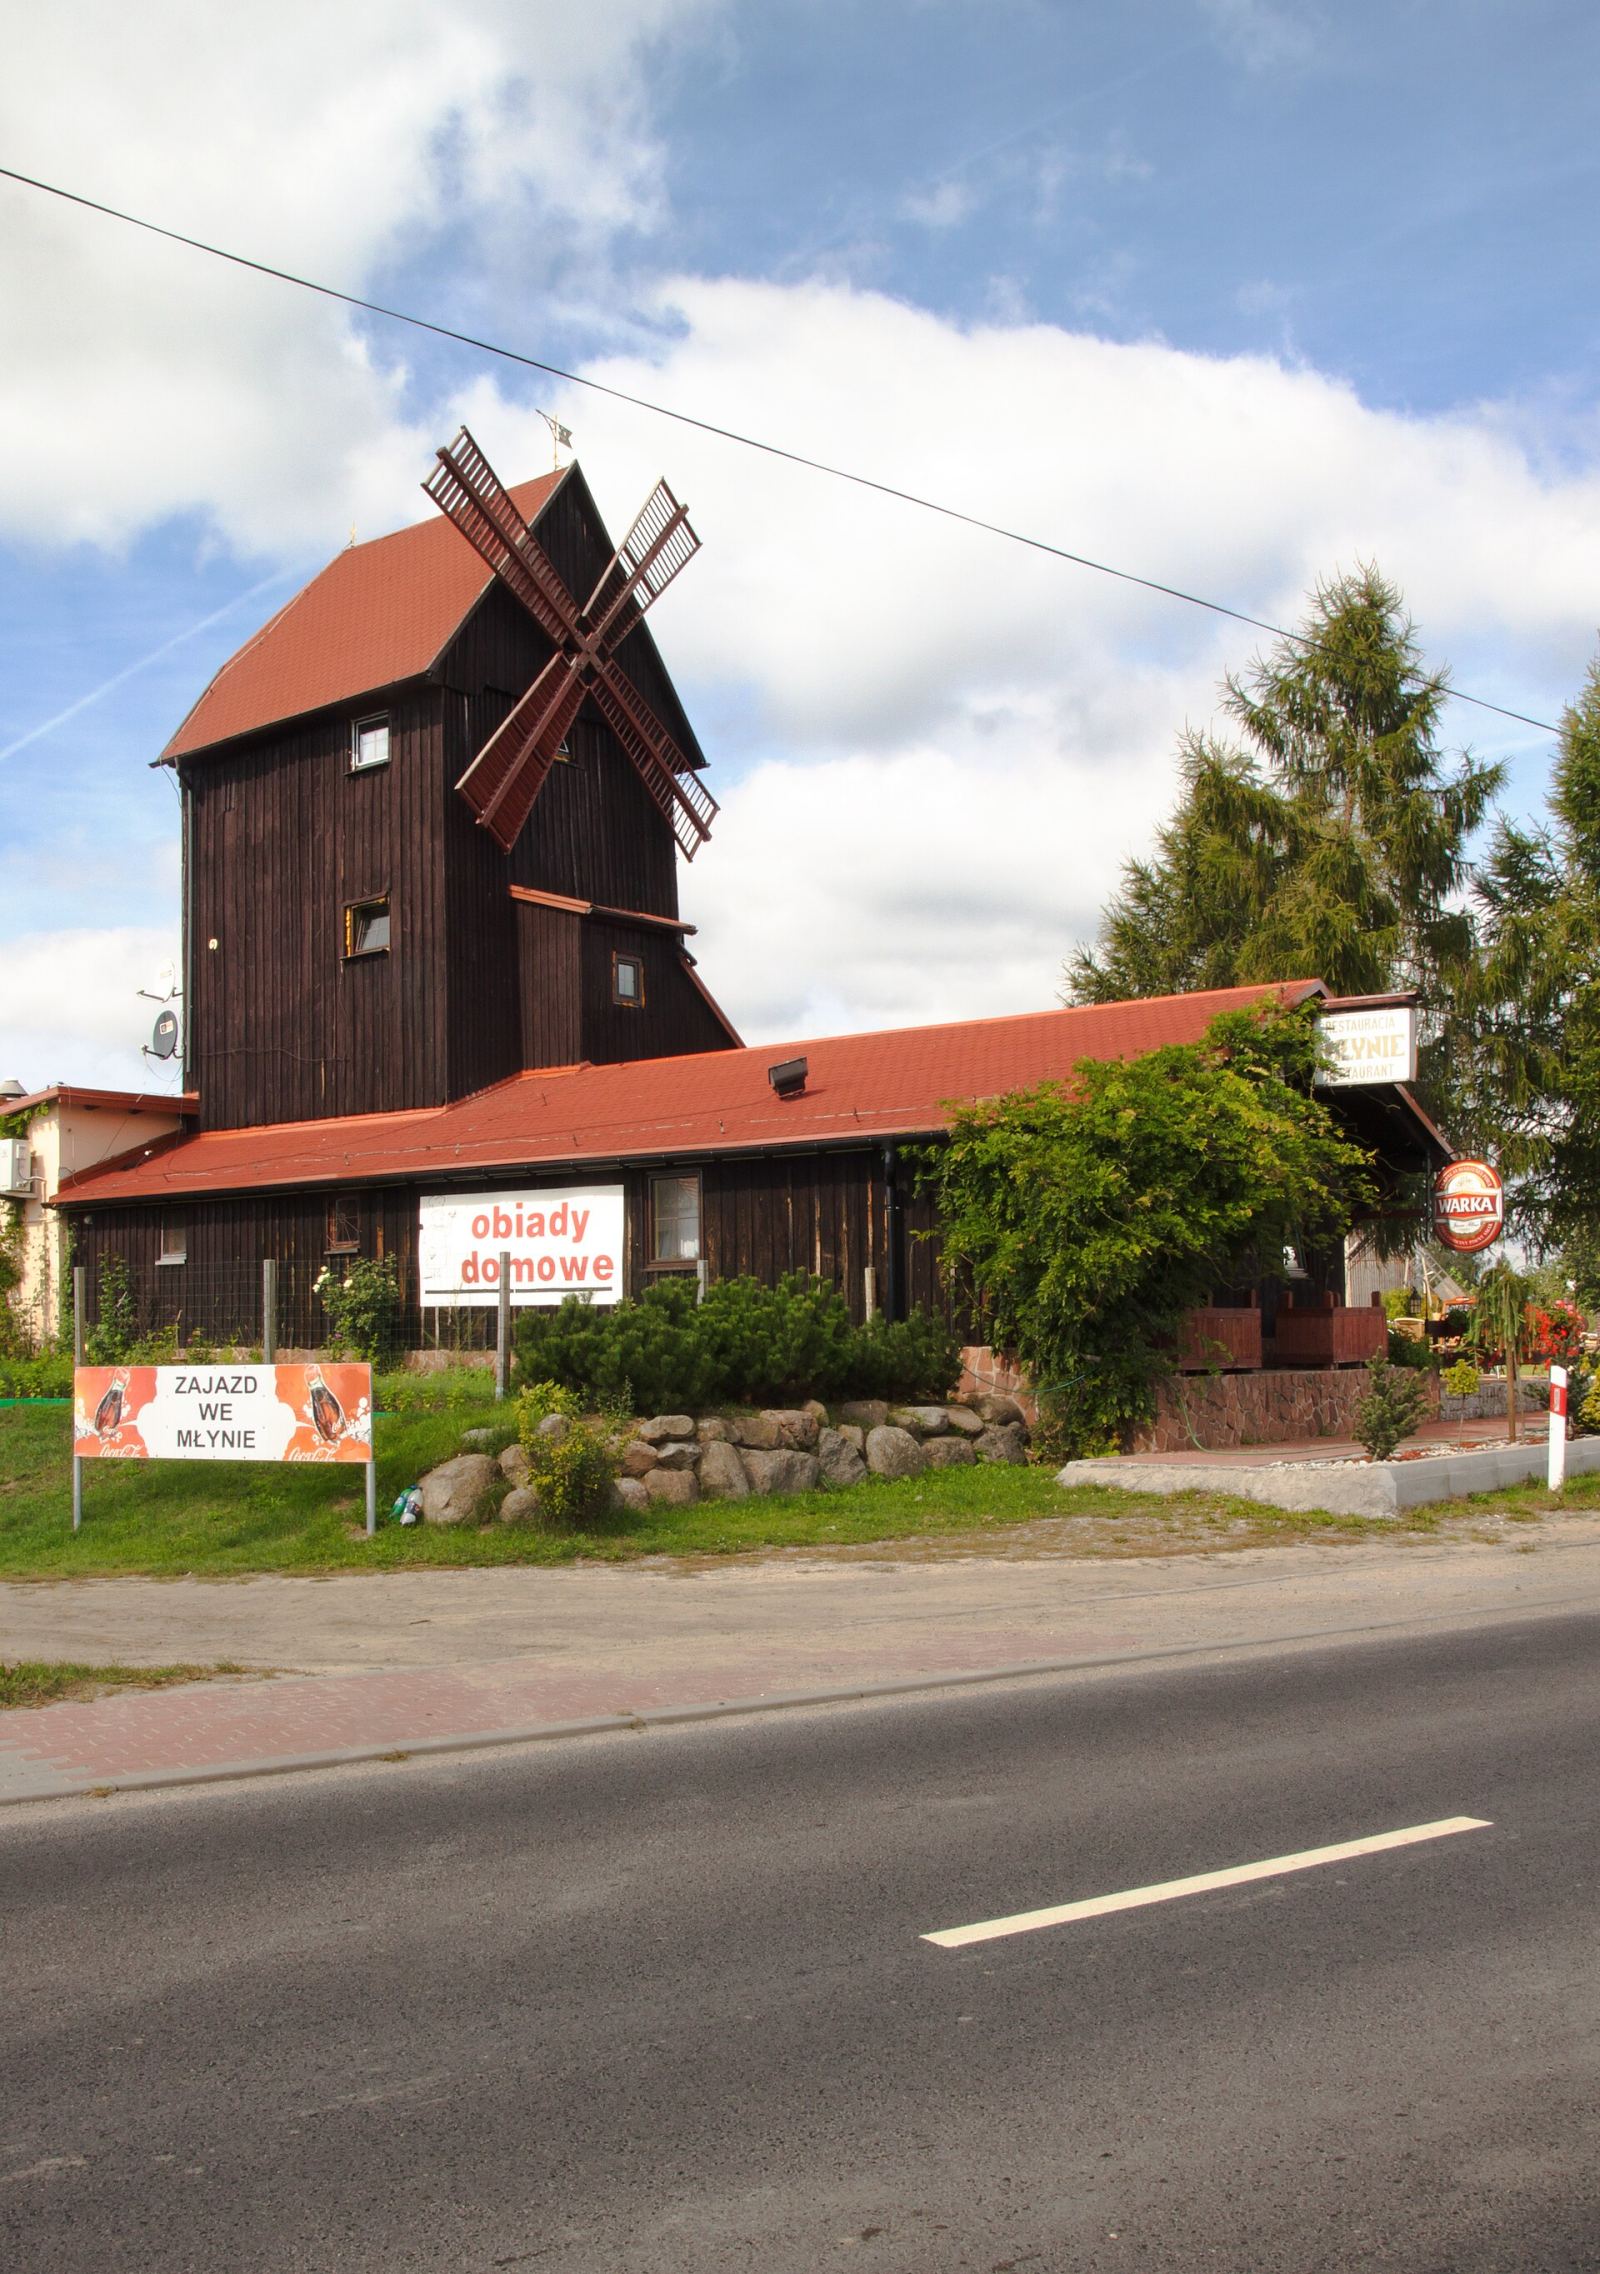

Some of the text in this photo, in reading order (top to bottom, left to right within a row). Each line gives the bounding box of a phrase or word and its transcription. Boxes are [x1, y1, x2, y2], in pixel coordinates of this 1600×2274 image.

[1438, 1197, 1494, 1214] WARKA
[471, 1201, 590, 1243] obiady
[461, 1251, 614, 1284] domowe
[174, 1375, 258, 1395] ZAJAZD
[198, 1403, 233, 1421] WE
[177, 1430, 256, 1449] MŁYNIE
